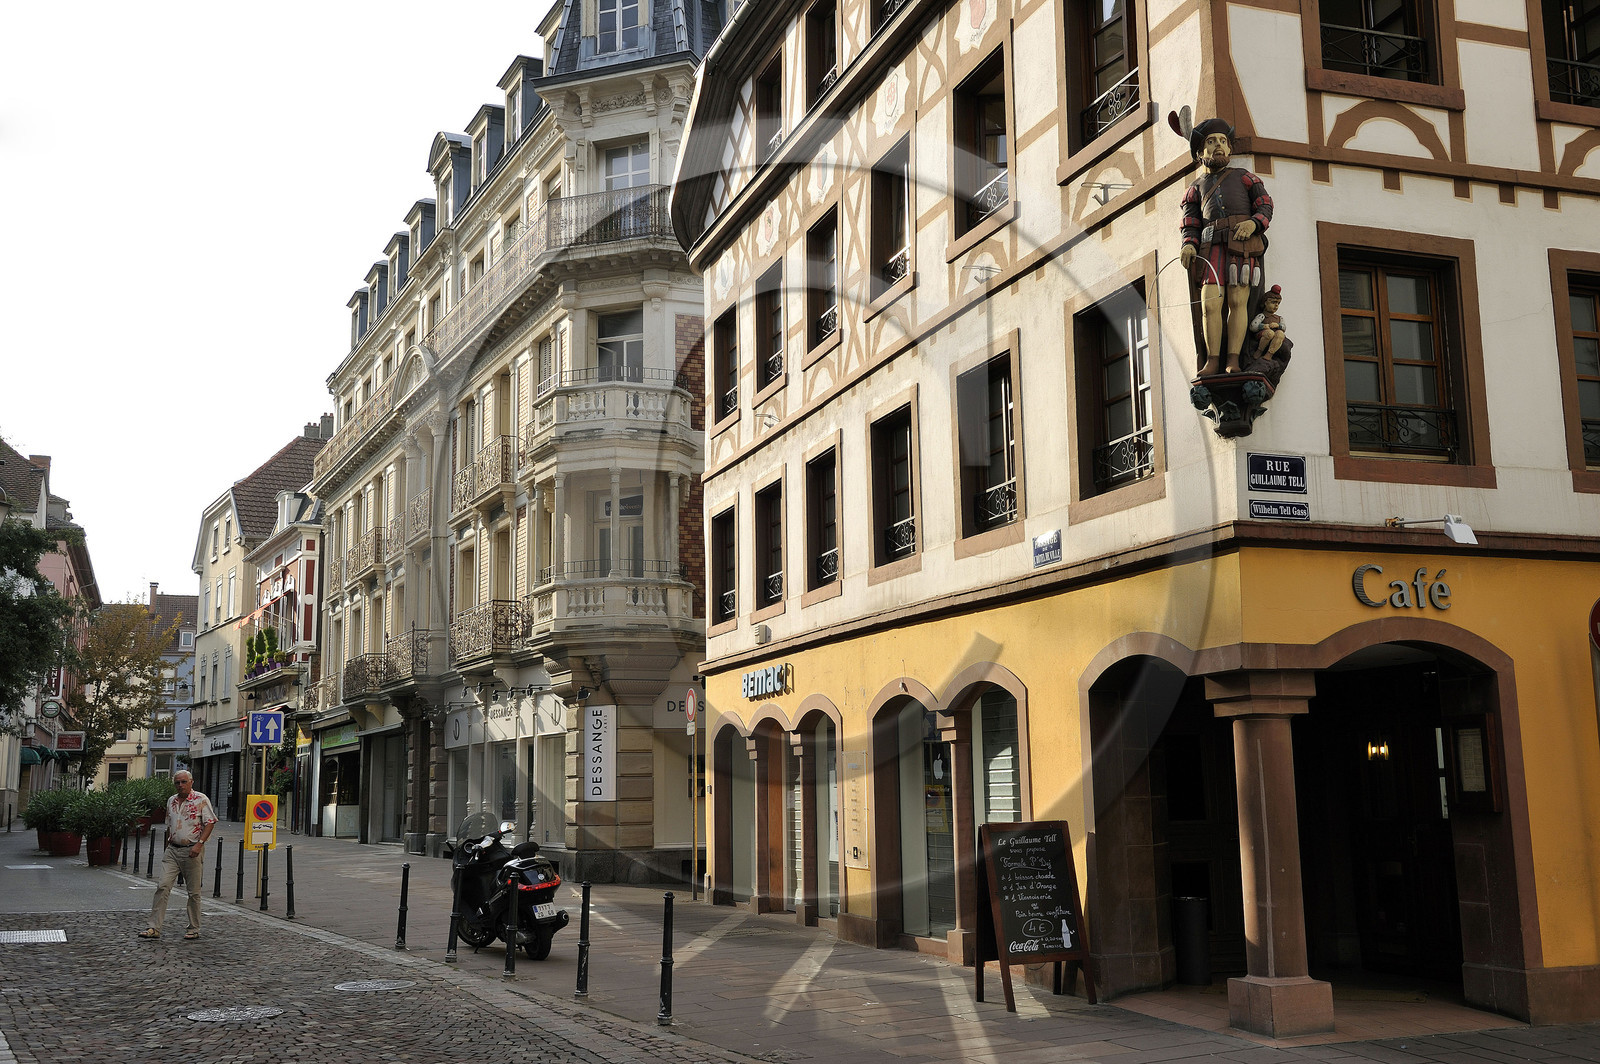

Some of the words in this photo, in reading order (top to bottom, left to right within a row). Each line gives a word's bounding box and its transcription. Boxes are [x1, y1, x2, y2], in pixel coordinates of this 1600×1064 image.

[1266, 460, 1290, 472] RUE
[1250, 473, 1287, 486] GUILLAUME
[1288, 475, 1305, 488] TELL
[1253, 504, 1279, 515] Wilhelm
[1279, 505, 1291, 516] Tell
[1292, 506, 1307, 516] Gass
[1352, 563, 1452, 610] Café
[489, 706, 514, 720] DESSANGE
[667, 700, 705, 713] DES
[592, 709, 603, 797] DESSANGE
[997, 838, 1006, 846] Le
[1009, 835, 1041, 848] Guillaume
[1044, 833, 1057, 843] Tell
[1015, 883, 1027, 891] Jus
